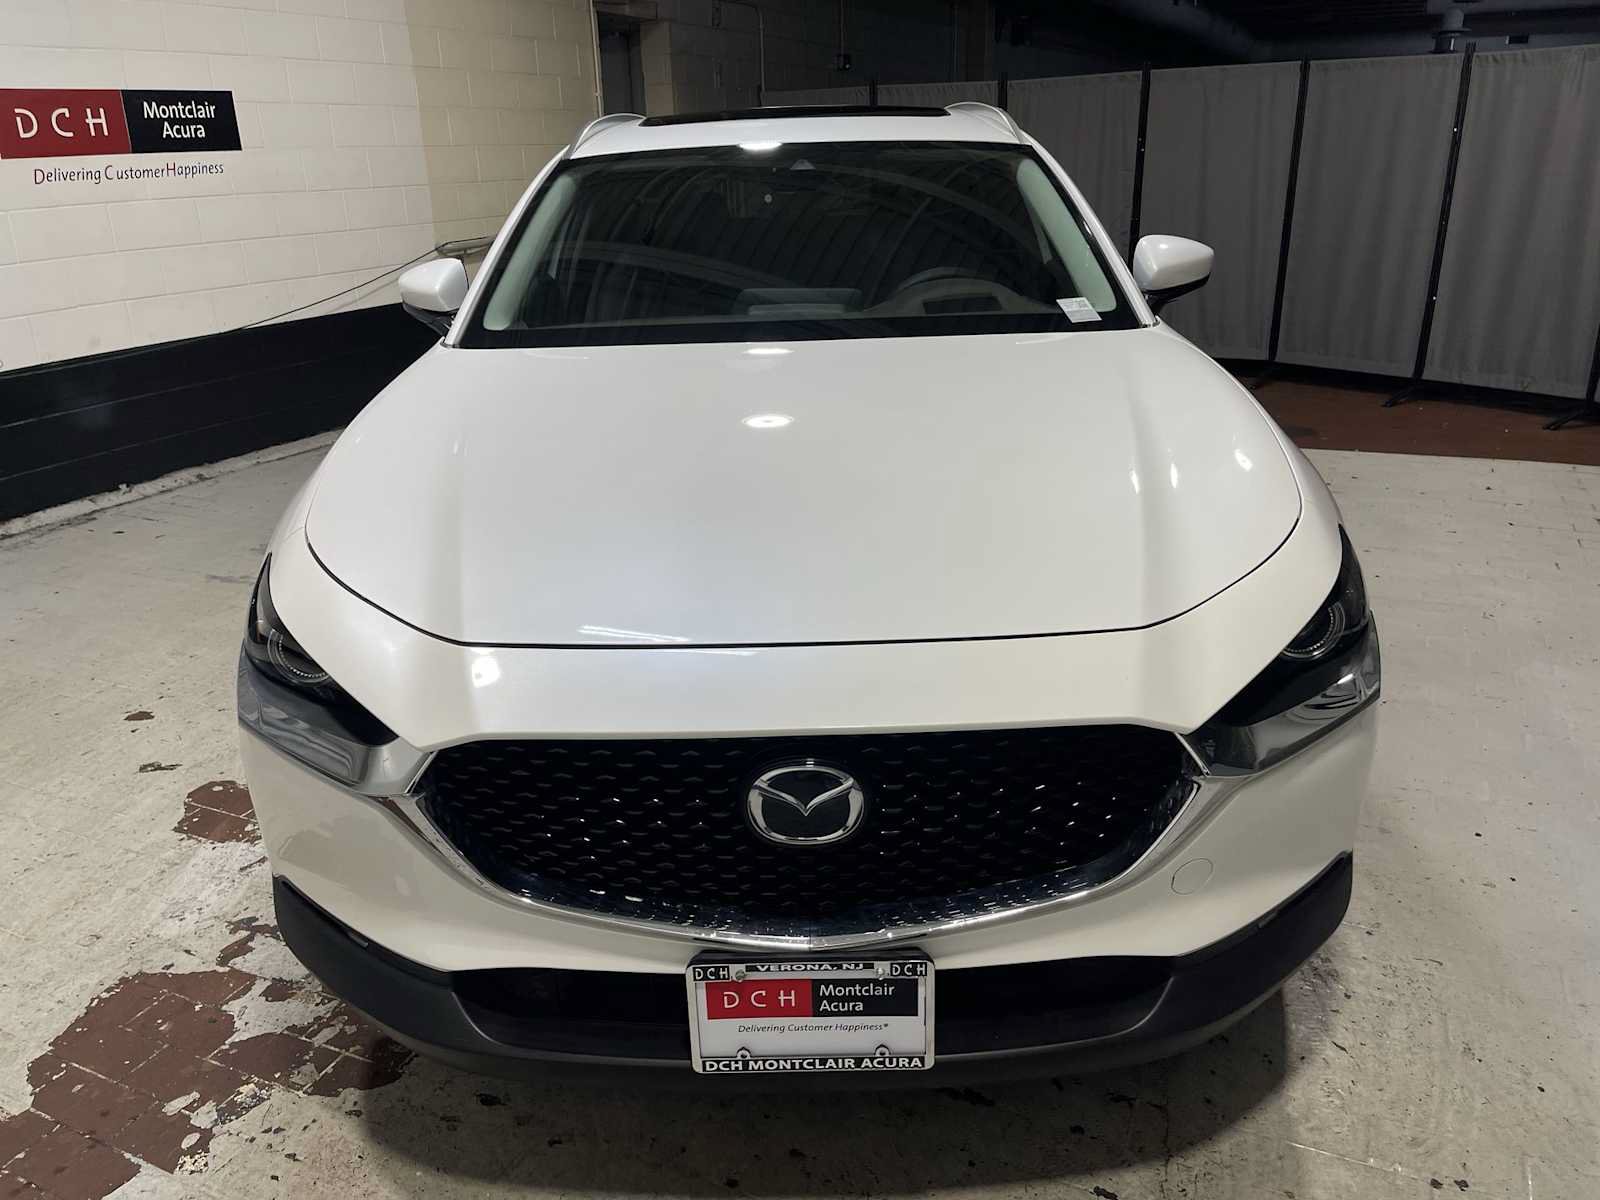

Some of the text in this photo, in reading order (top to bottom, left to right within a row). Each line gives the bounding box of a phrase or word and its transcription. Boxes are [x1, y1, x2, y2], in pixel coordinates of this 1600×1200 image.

[143, 101, 216, 119] Montclair
[14, 107, 109, 138] DCH
[162, 121, 206, 138] Acura
[34, 168, 101, 185] Delivering
[694, 968, 729, 980] DCH
[891, 964, 926, 976] DCH
[819, 984, 895, 997] Montclair
[723, 990, 796, 1008] DCH
[819, 1000, 864, 1012] Acura
[738, 1024, 785, 1033] Delivering
[788, 1023, 833, 1032] Customer
[705, 1057, 922, 1071] DCH MONTCLAIR ACURA
